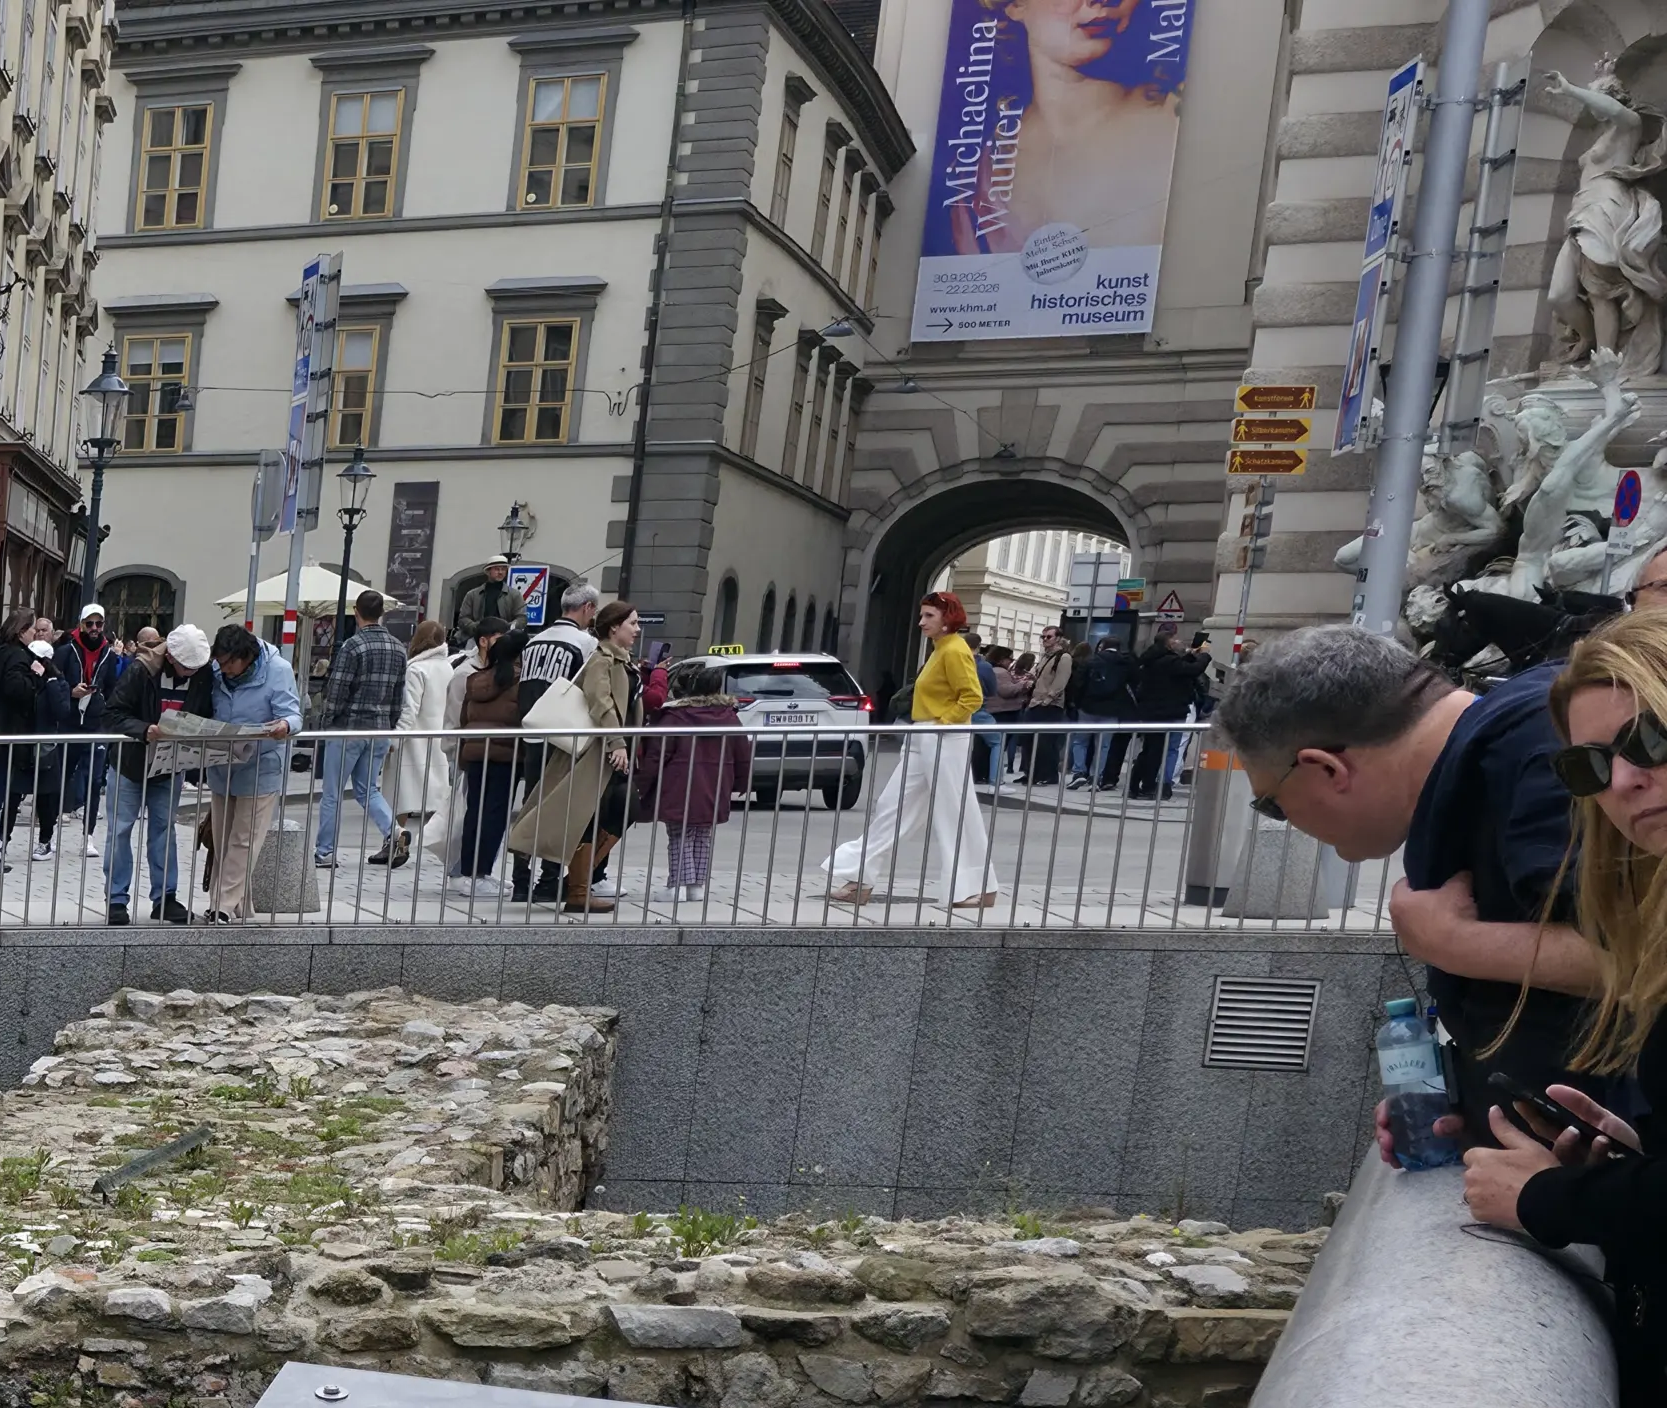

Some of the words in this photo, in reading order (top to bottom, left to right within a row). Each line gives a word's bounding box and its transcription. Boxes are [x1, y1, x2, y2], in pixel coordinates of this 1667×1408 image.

[942, 18, 997, 208] Michaelina
[975, 103, 1024, 238] Wautier
[933, 271, 987, 283] 30.9.2025
[1096, 272, 1150, 290] kunst
[945, 283, 1000, 295] 22.2.2026
[1030, 290, 1147, 309] historisches
[929, 303, 997, 314] www.khm.at
[958, 321, 977, 329] 500
[978, 320, 1011, 328] METER
[1061, 309, 1145, 325] museum
[714, 647, 739, 655] TAXI
[520, 643, 574, 684] HICAGO
